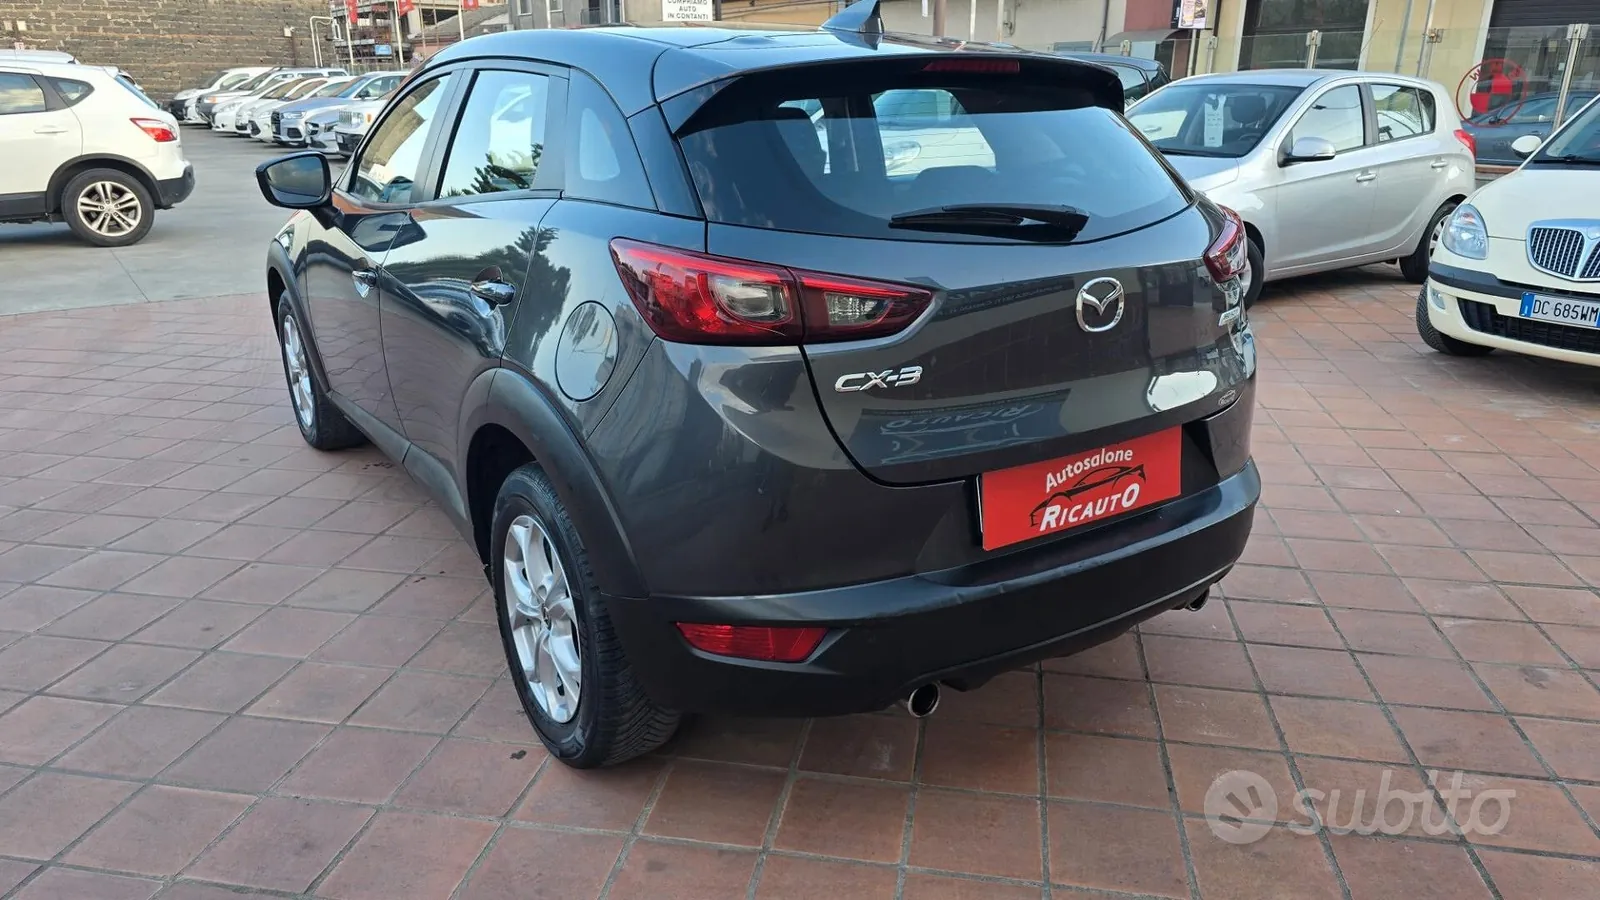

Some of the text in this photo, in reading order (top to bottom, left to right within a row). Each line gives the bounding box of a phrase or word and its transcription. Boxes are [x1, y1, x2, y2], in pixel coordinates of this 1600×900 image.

[676, 12, 709, 20] CONTANTI
[1533, 299, 1600, 322] DC 685WM
[834, 365, 923, 392] CX-3
[1046, 448, 1133, 493] Autosalone
[1039, 482, 1140, 532] RICAUTO
